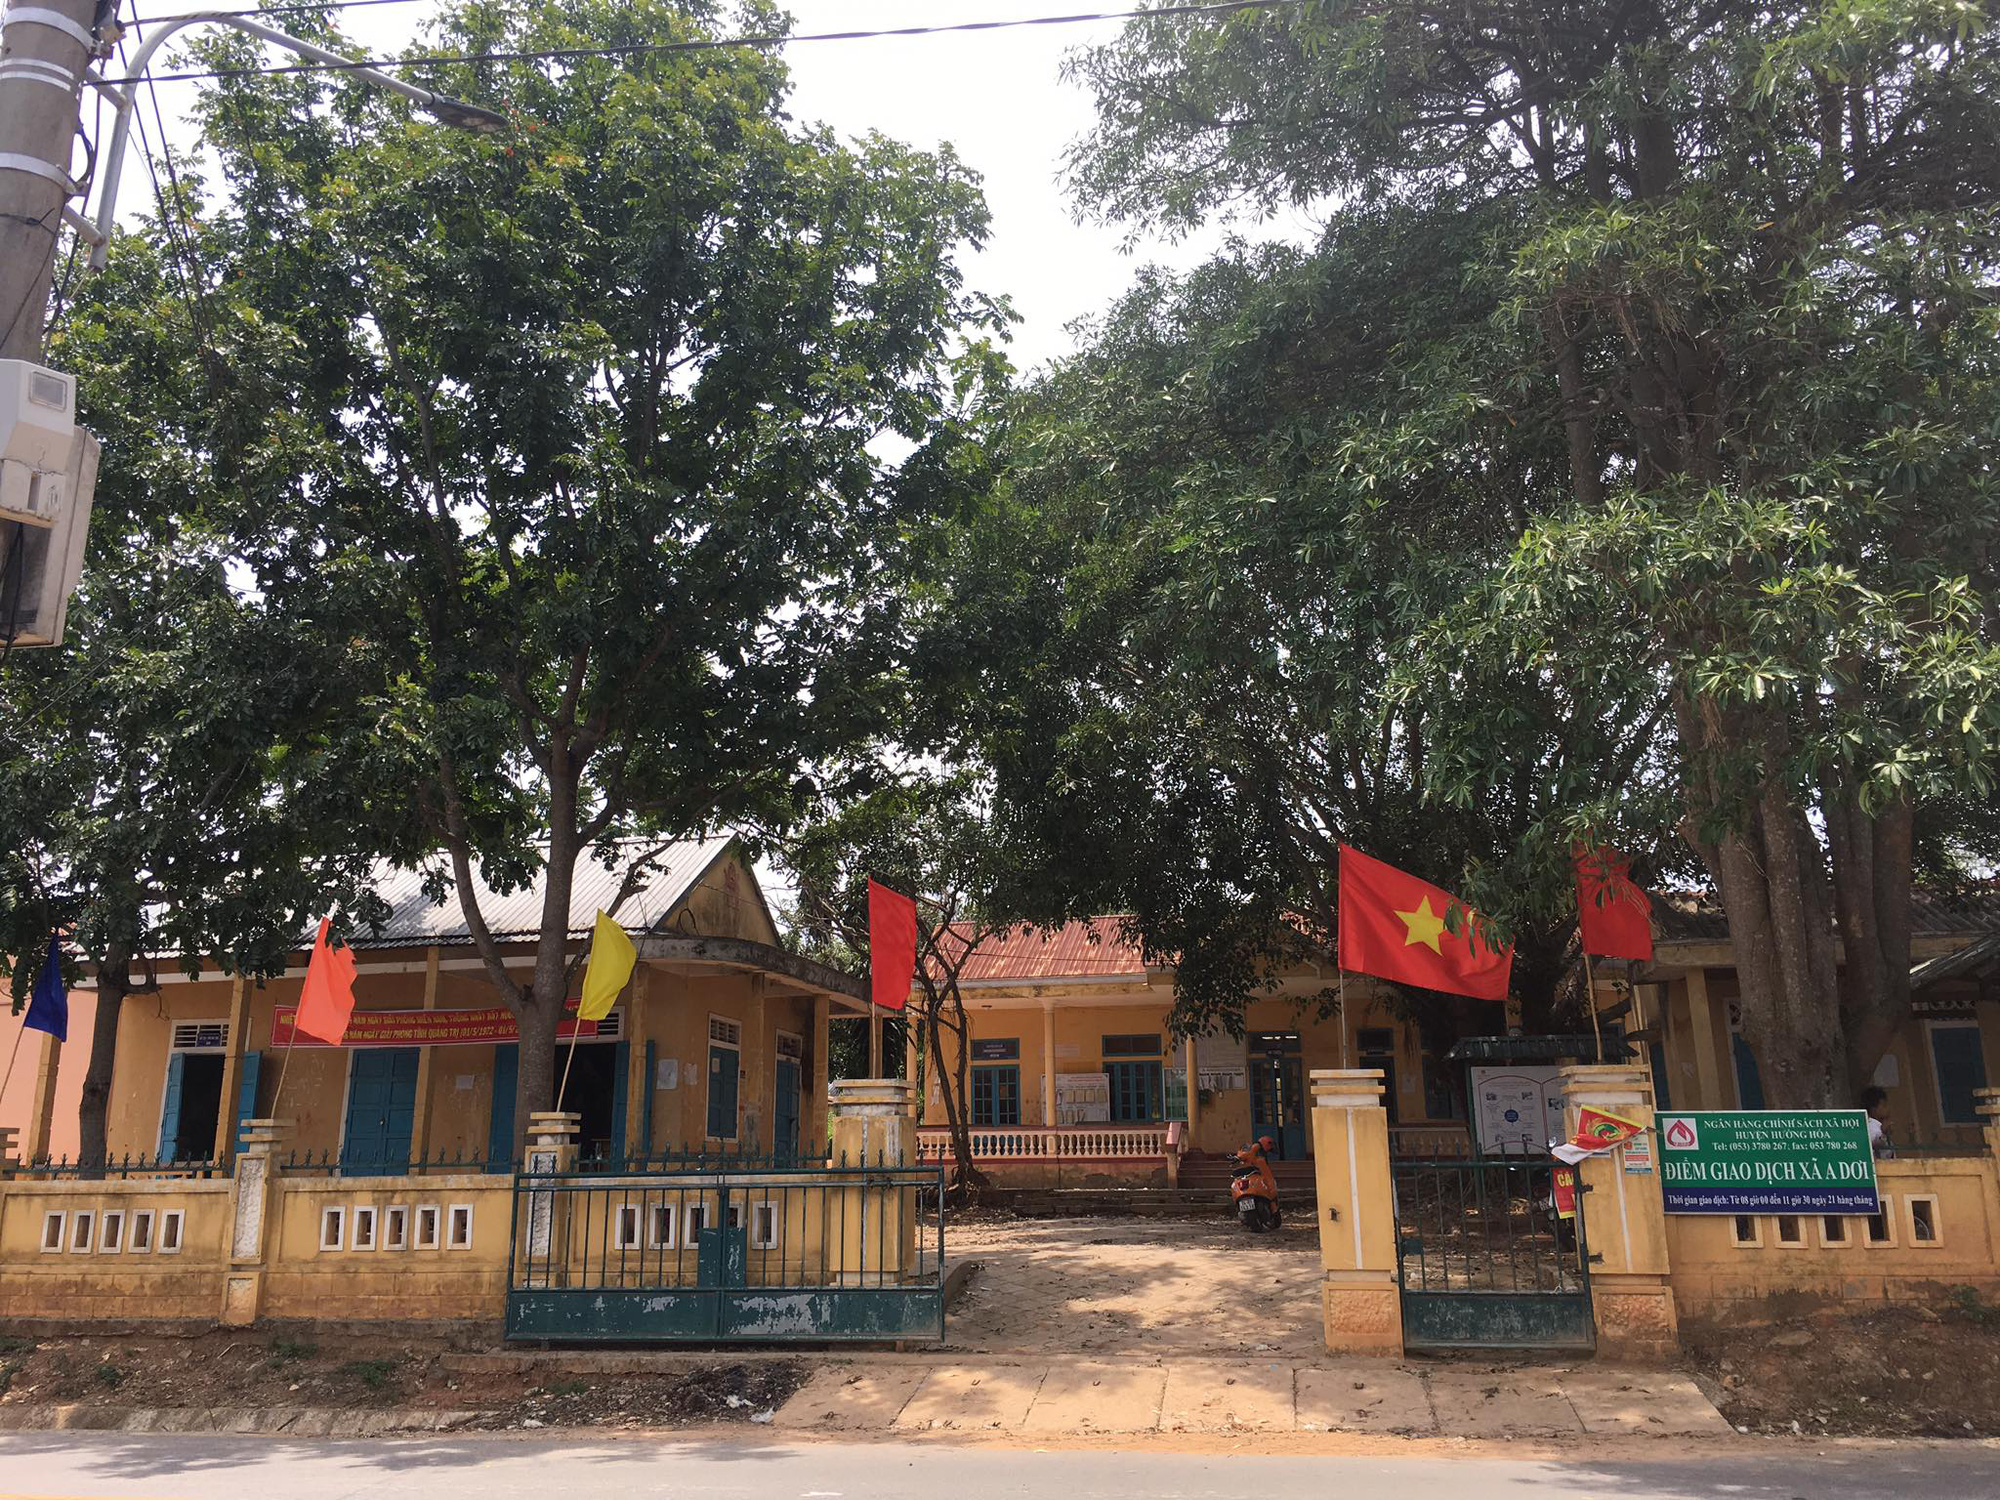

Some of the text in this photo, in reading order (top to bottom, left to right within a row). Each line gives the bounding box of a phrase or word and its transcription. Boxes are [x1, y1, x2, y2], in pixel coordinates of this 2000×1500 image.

[1704, 1118, 1731, 1129] NGÂN
[1734, 1117, 1761, 1129] HÀNG
[1797, 1117, 1823, 1128] SÁCH
[1825, 1117, 1839, 1128] XÃ
[1841, 1117, 1860, 1130] HỘI
[1735, 1128, 1769, 1141] HUYỆN
[1712, 1142, 1728, 1151] Tel:
[1729, 1142, 1750, 1152] (053)
[1752, 1142, 1771, 1151] 3780
[1792, 1141, 1808, 1150] fax:
[1809, 1141, 1825, 1150] 053
[1827, 1141, 1841, 1150] 780
[1842, 1141, 1858, 1150] 268
[1665, 1156, 1707, 1180] ĐIỂM
[1710, 1161, 1752, 1181] GIAO
[1754, 1161, 1796, 1185] DỊCH
[1798, 1157, 1823, 1180] XÃ
[1825, 1161, 1837, 1180] A
[1668, 1194, 1684, 1205] Thời
[1685, 1195, 1698, 1206] gian
[1699, 1195, 1712, 1206] giao
[1713, 1195, 1729, 1206] dịch:
[1730, 1194, 1740, 1205] Từ
[1740, 1195, 1749, 1205] 08
[1760, 1195, 1769, 1205] 00
[1782, 1195, 1790, 1205] 11
[1802, 1195, 1811, 1205] 30
[1811, 1194, 1827, 1206] ngày
[1828, 1195, 1835, 1204] 21
[1836, 1195, 1853, 1206] hàng
[1854, 1195, 1873, 1206] tháng
